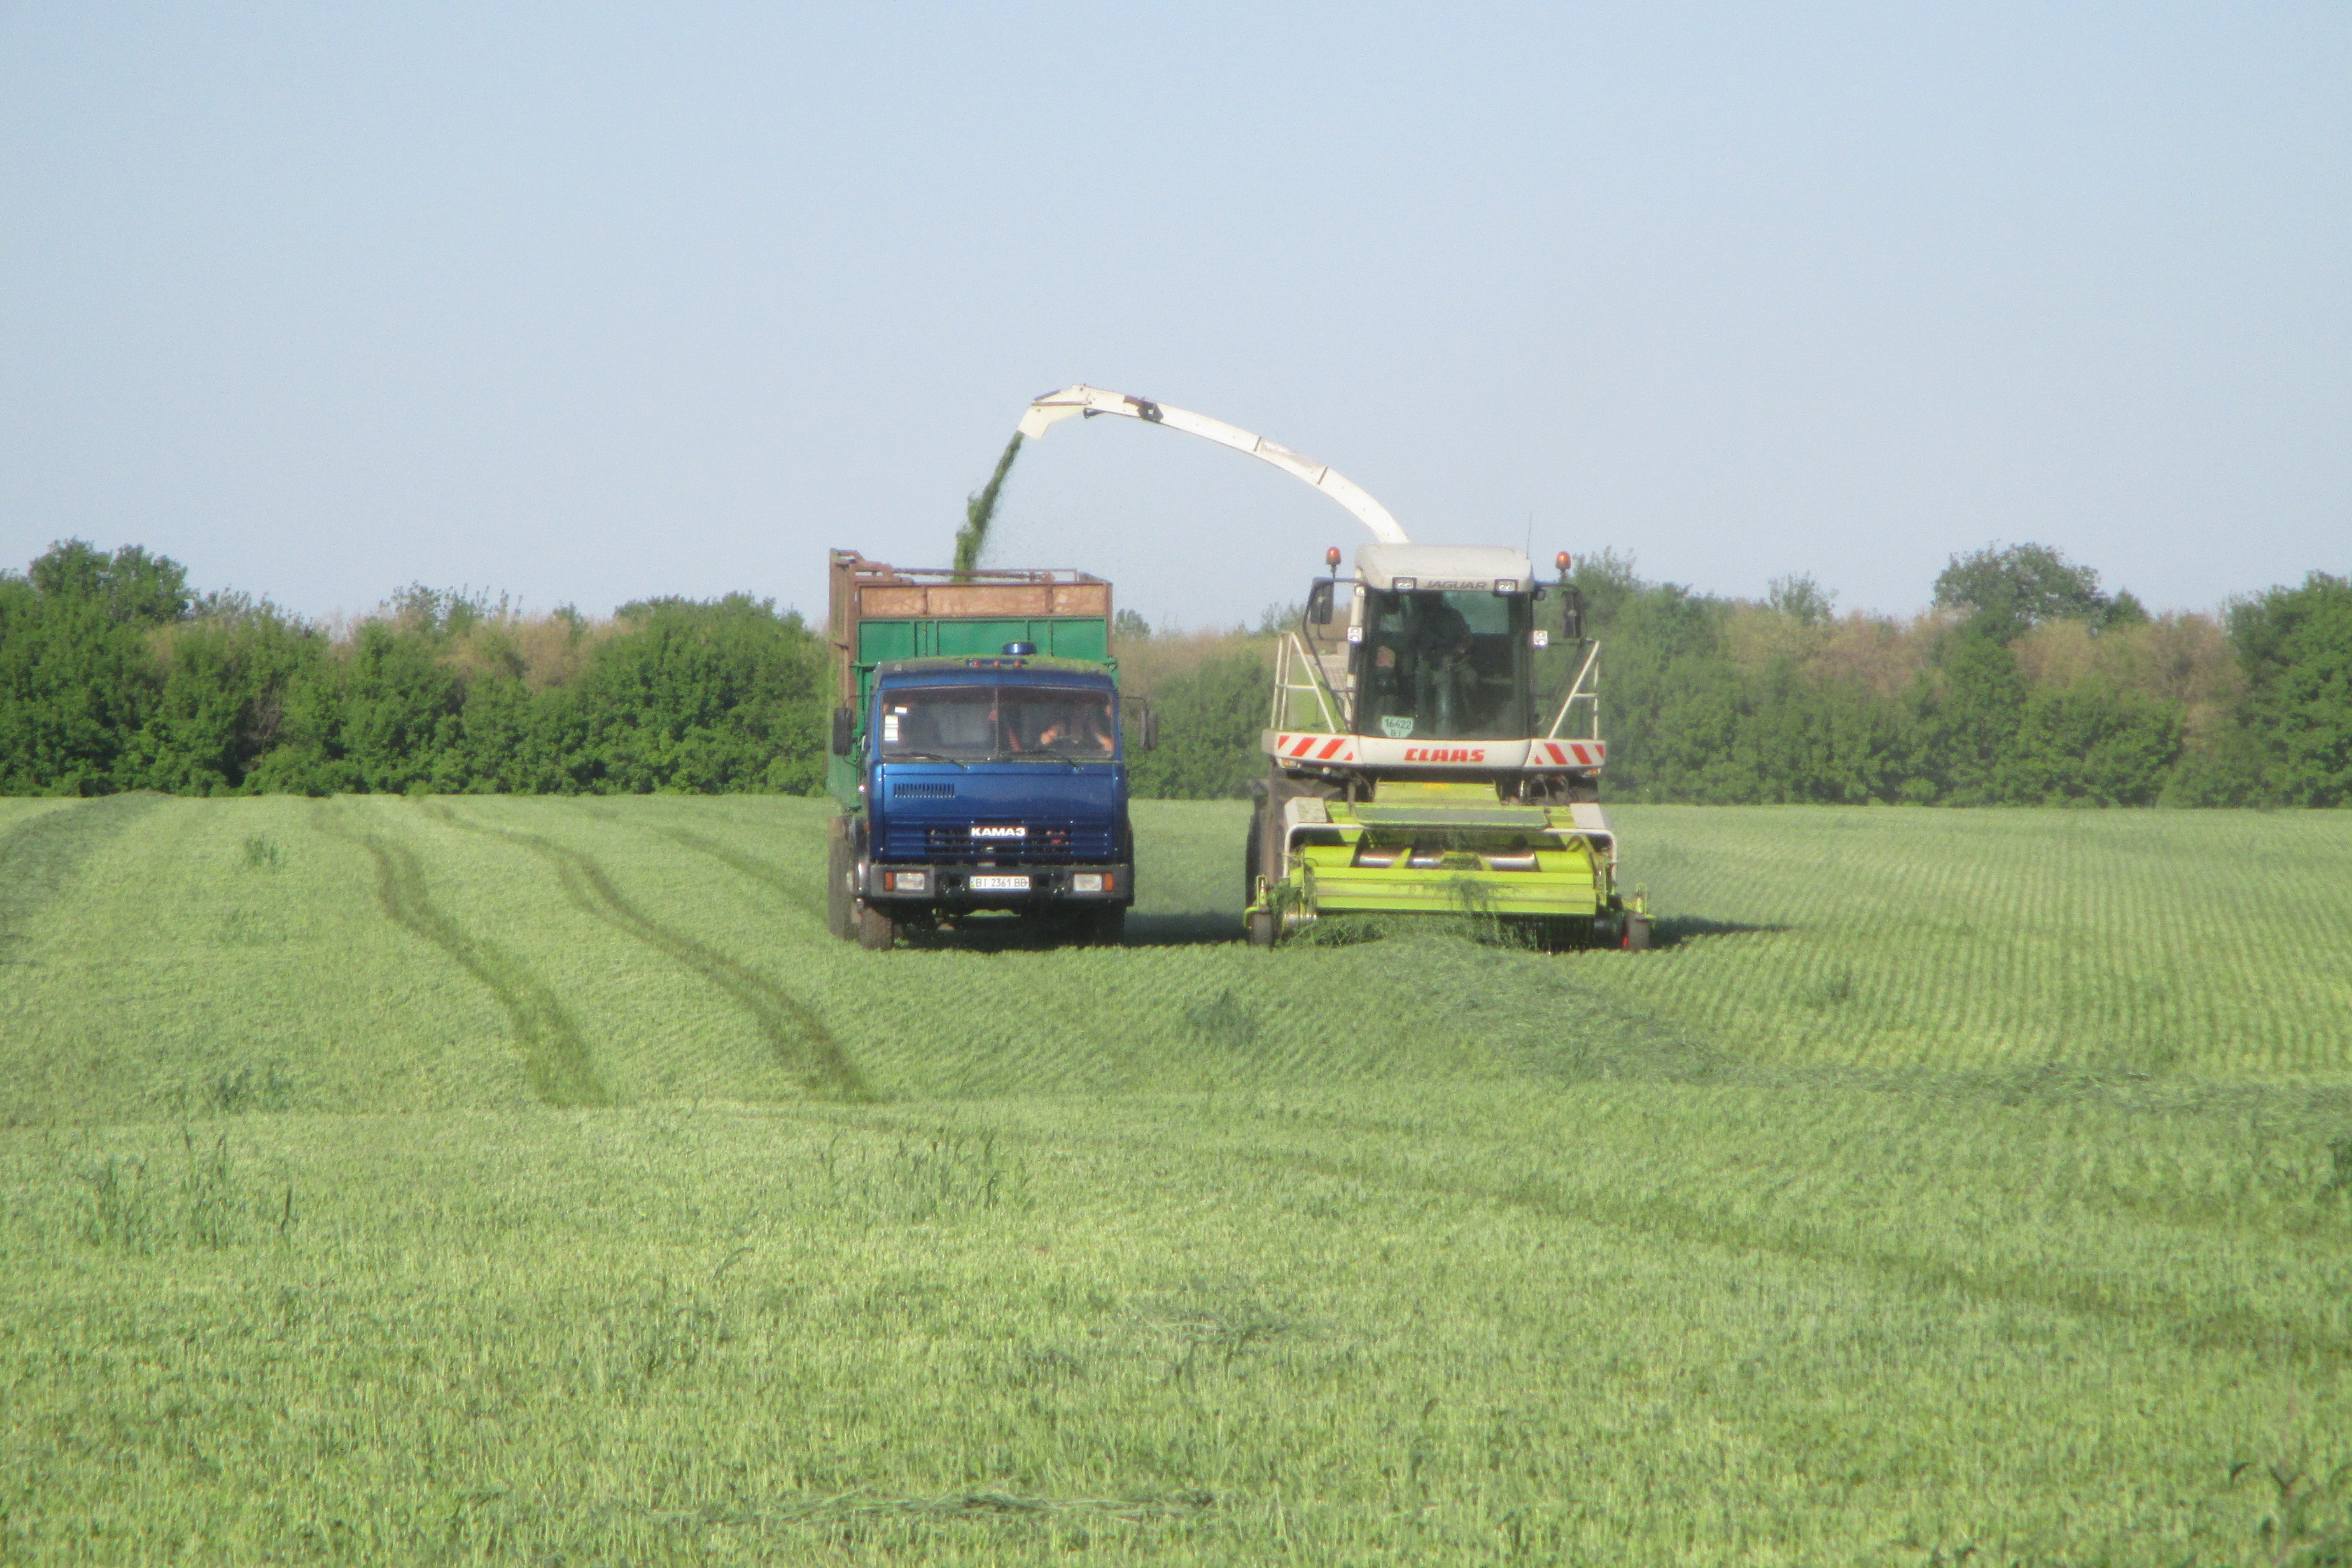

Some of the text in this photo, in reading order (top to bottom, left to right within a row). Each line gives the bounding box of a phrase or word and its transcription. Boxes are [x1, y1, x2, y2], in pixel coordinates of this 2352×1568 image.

[1425, 580, 1487, 589] JAGUAR
[1384, 718, 1412, 729] 16422
[1404, 748, 1485, 762] CLAAS
[971, 827, 1026, 837] КАМАЗ
[991, 878, 1011, 887] 2361
